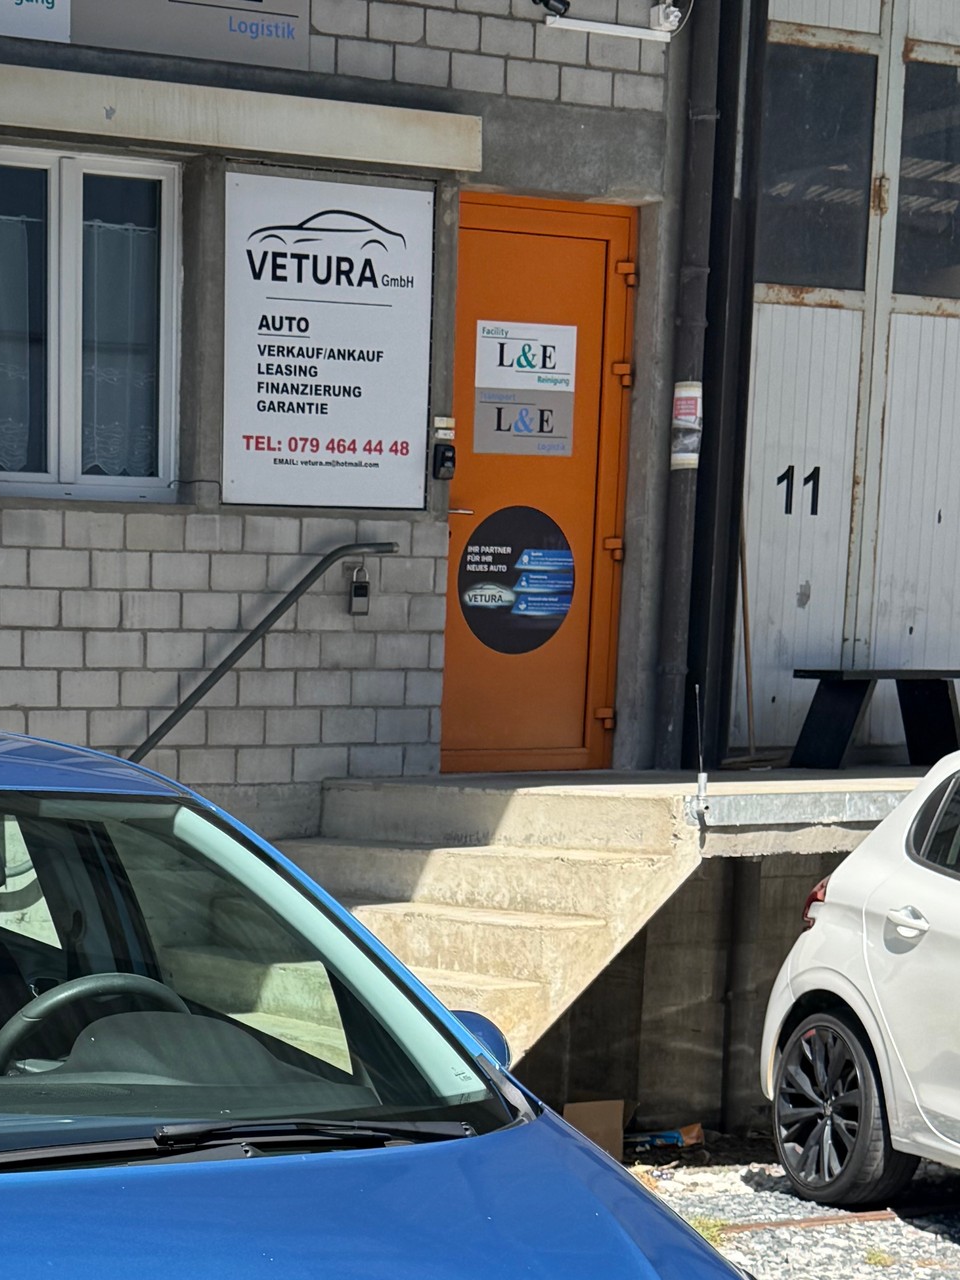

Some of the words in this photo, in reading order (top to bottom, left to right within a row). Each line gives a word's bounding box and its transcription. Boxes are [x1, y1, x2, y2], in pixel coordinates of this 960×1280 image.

[229, 16, 295, 40] Logistik
[246, 249, 379, 288] VETURA
[381, 274, 414, 288] GmbH
[258, 315, 310, 333] AUTO
[482, 326, 509, 338] Facility
[257, 344, 384, 363] VERKAUF/ANKAUF
[497, 342, 556, 370] L&E
[257, 363, 318, 378] LEASING
[537, 376, 570, 386] Reinigung
[257, 381, 362, 398] FINANZIERUNG
[256, 400, 328, 415] GARANTIE
[494, 407, 554, 433] L&E
[243, 435, 282, 452] TEL:
[288, 436, 320, 454] 079
[325, 438, 357, 455] 464
[363, 439, 383, 456] 44
[389, 440, 409, 456] 48
[273, 458, 299, 466] EMAIL:
[776, 465, 821, 516] 11
[467, 545, 480, 553] IHR
[481, 546, 512, 554] PARTNER
[466, 553, 480, 562] FÜR
[481, 555, 493, 563] IHR
[466, 564, 488, 572] NEUES
[489, 564, 507, 572] AUTO
[467, 594, 504, 603] VETURA
